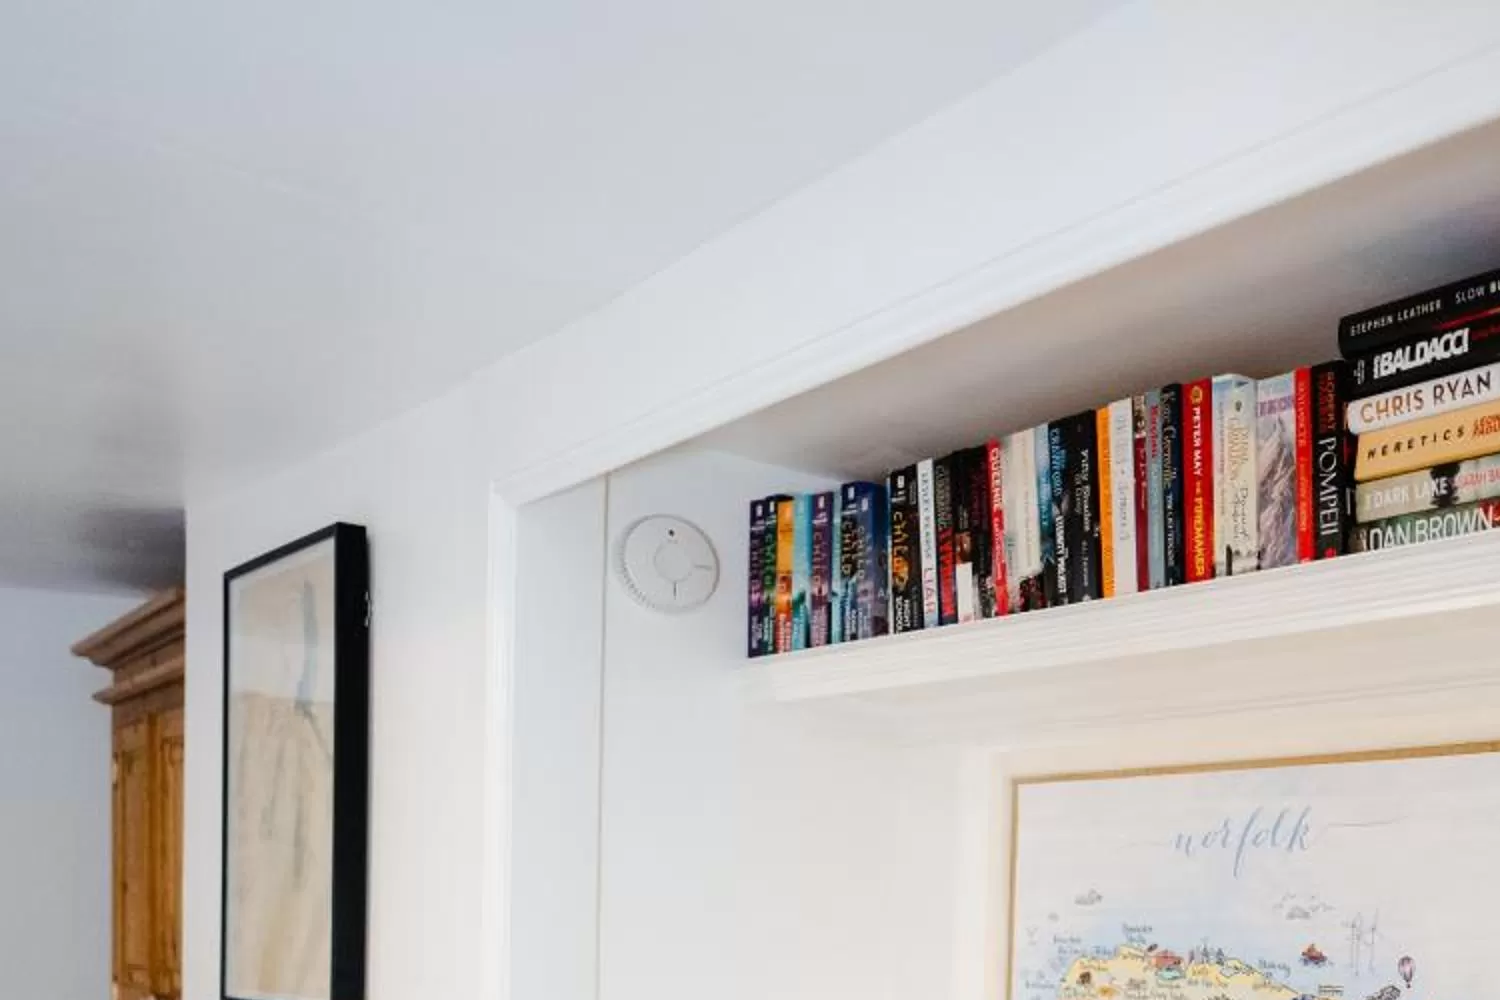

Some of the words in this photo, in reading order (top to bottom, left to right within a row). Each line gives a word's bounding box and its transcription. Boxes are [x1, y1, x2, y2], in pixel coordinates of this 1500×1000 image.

[1350, 315, 1394, 337] STEPHEN
[1397, 298, 1442, 322] LEATHER
[1455, 286, 1486, 304] SLOW
[1380, 328, 1470, 376] BALDACCI
[1359, 390, 1424, 423] CHRIS
[1433, 371, 1492, 406] RYAN
[1192, 406, 1202, 447] PETER
[1367, 426, 1465, 460] HERETICS
[1193, 449, 1203, 476] MAY
[1318, 436, 1340, 535] POMPEII
[1372, 485, 1409, 509] DARK
[1414, 477, 1448, 498] LAKE
[1193, 496, 1206, 577] FIREMAKER
[1370, 520, 1411, 551] DAN
[1415, 505, 1493, 544] BROWN
[924, 567, 935, 614] LIAR
[1172, 803, 1313, 880] norfolk
